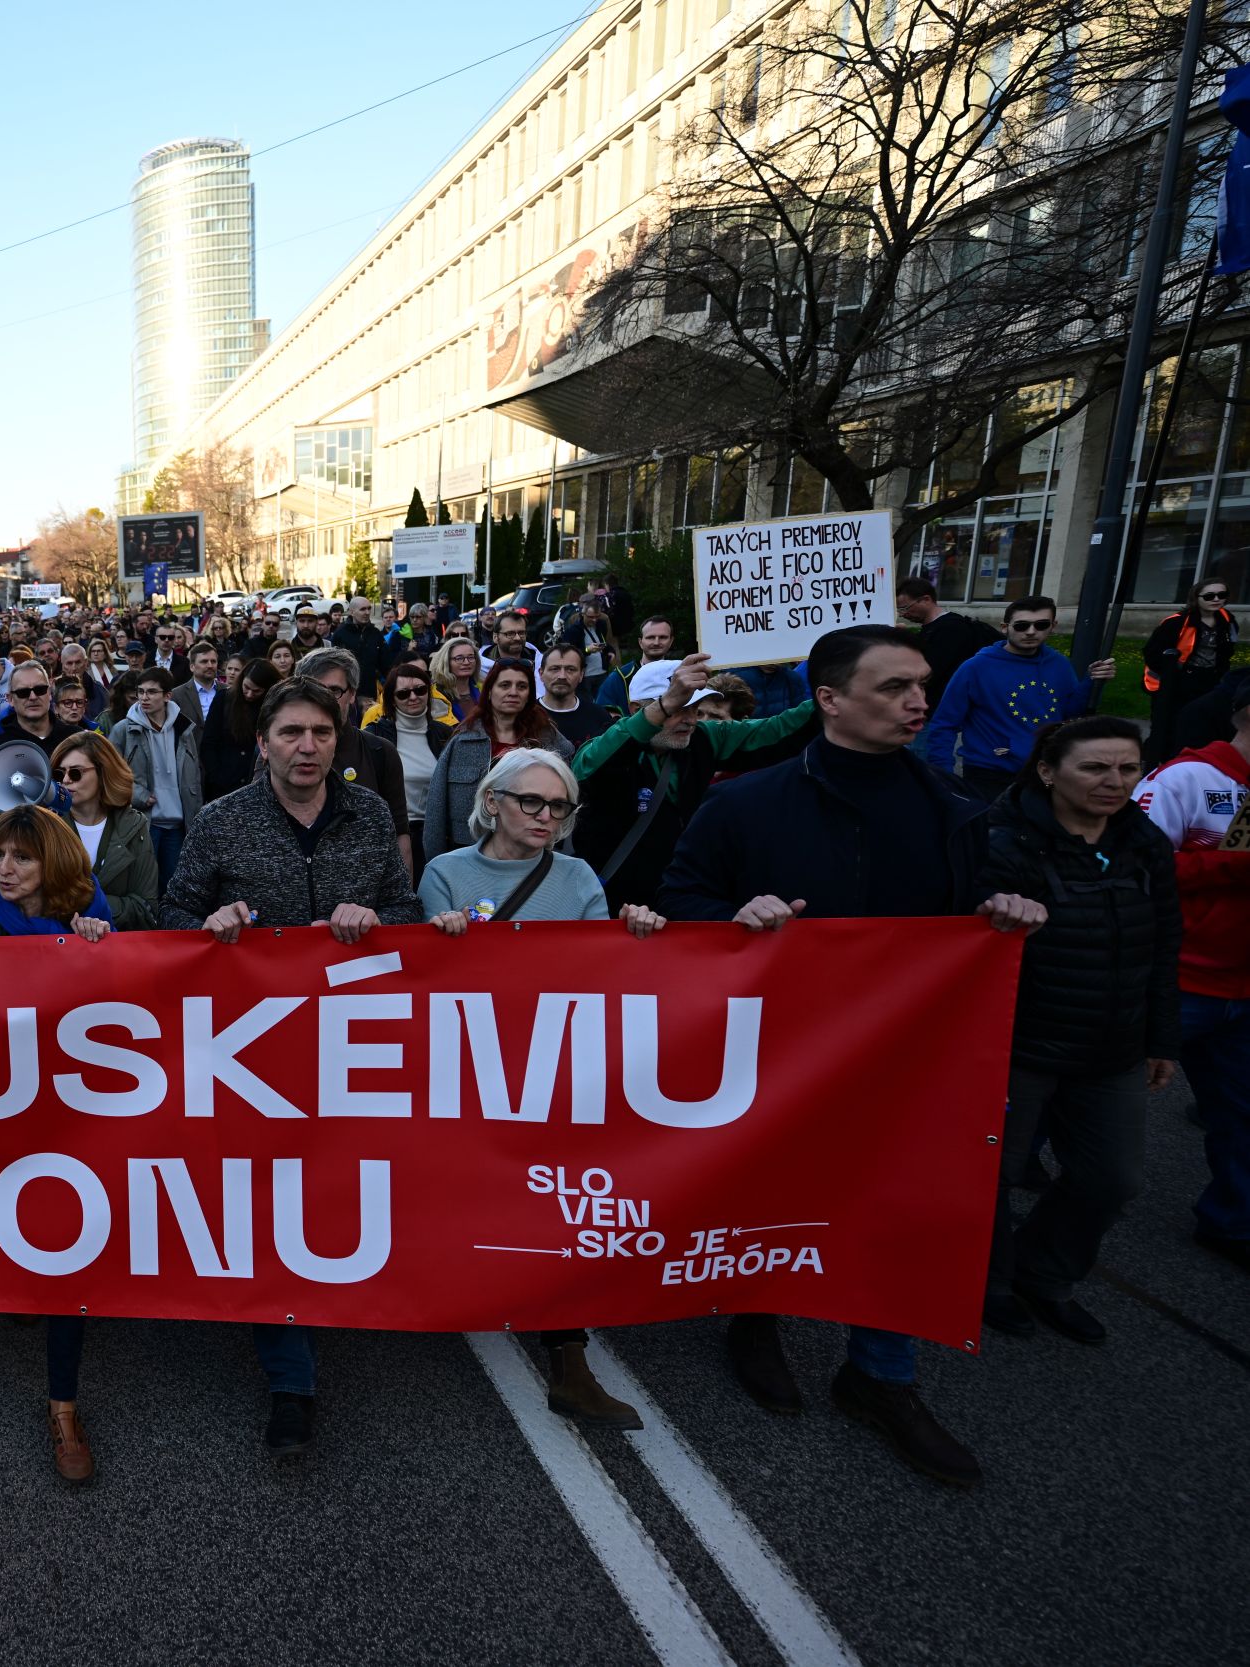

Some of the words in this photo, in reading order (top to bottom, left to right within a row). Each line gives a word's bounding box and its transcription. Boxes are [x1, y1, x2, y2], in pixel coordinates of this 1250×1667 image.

[706, 527, 771, 556] TAKÝCH
[781, 520, 862, 548] PREMIEROV
[709, 559, 742, 586] AKO
[750, 556, 774, 580] JE
[782, 551, 823, 577] FICO
[832, 540, 863, 572] KEĎ
[706, 584, 772, 611] KOPNEM
[779, 582, 803, 604] DO
[811, 573, 876, 600] STROMU
[725, 610, 775, 635] PADNE
[787, 605, 823, 629] STO
[526, 1164, 613, 1196] SLO
[557, 1194, 650, 1228] VEN
[576, 1230, 666, 1258] SKO
[683, 1227, 729, 1257] JE
[661, 1242, 824, 1286] EURÓPA
